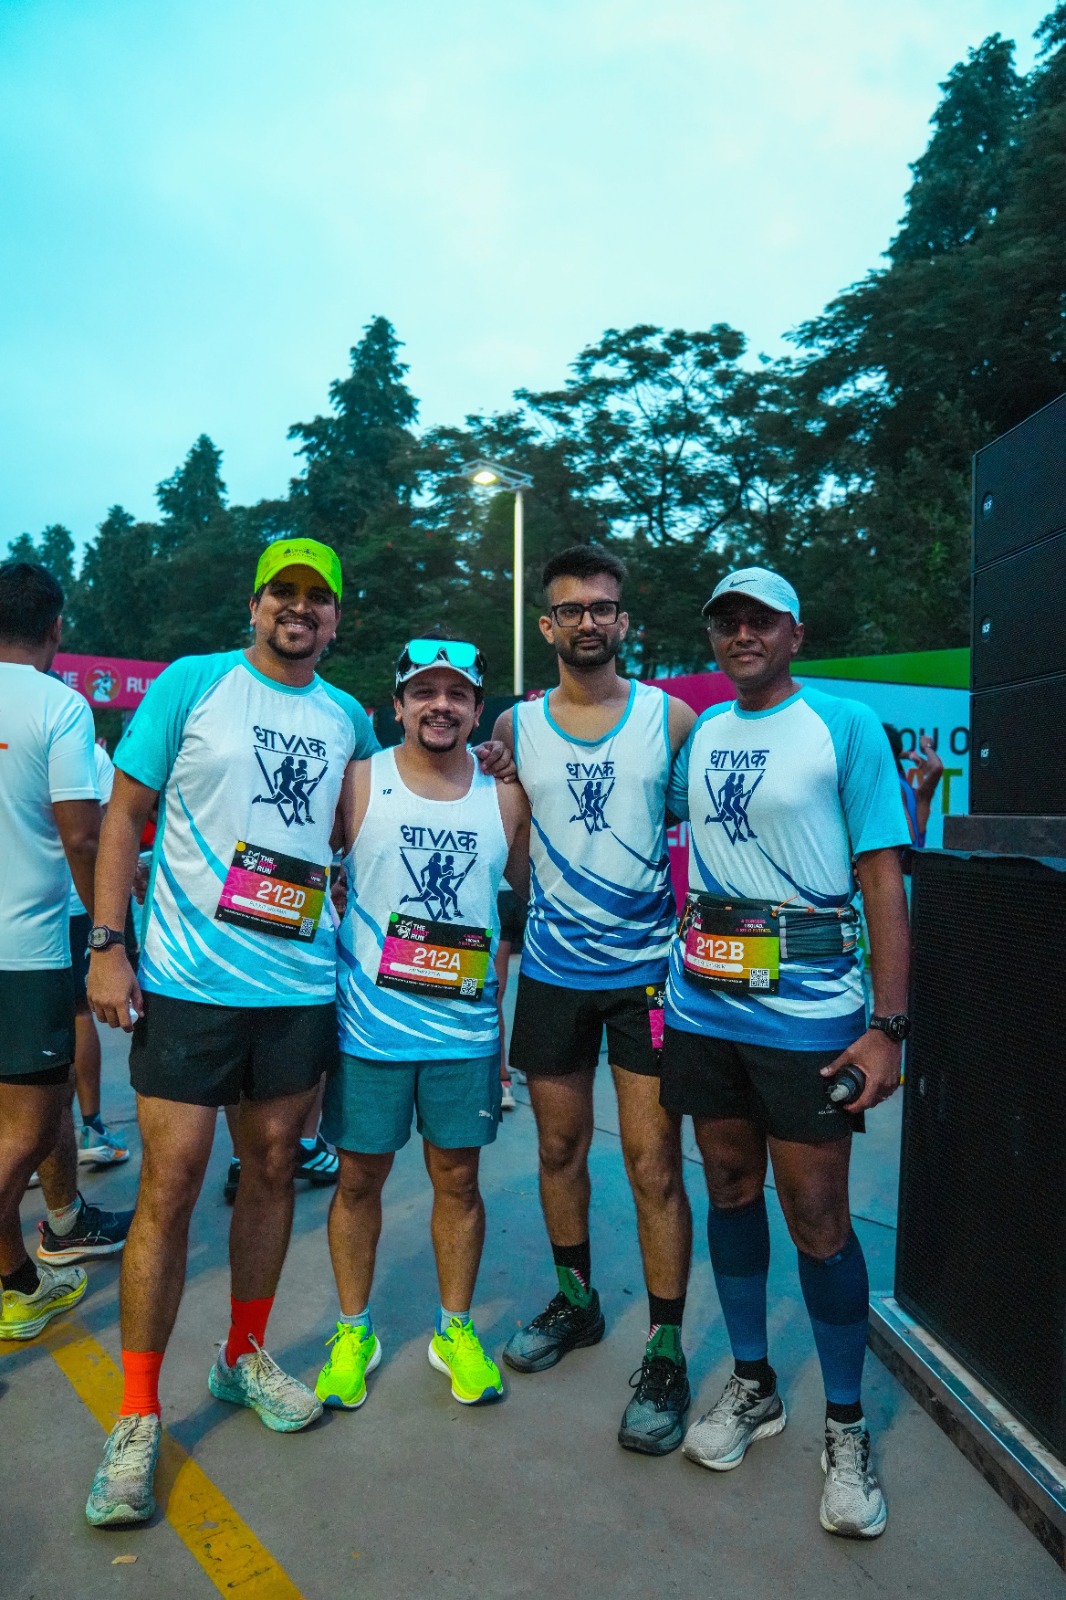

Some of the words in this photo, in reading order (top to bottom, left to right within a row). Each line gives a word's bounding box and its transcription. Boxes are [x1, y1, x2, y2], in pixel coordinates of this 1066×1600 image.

[897, 727, 938, 756] OU
[256, 865, 273, 875] RUN
[260, 854, 275, 865] THE
[256, 880, 306, 909] 212D
[412, 923, 426, 931] THE
[412, 947, 461, 971] 212A
[696, 936, 745, 961] 212B
